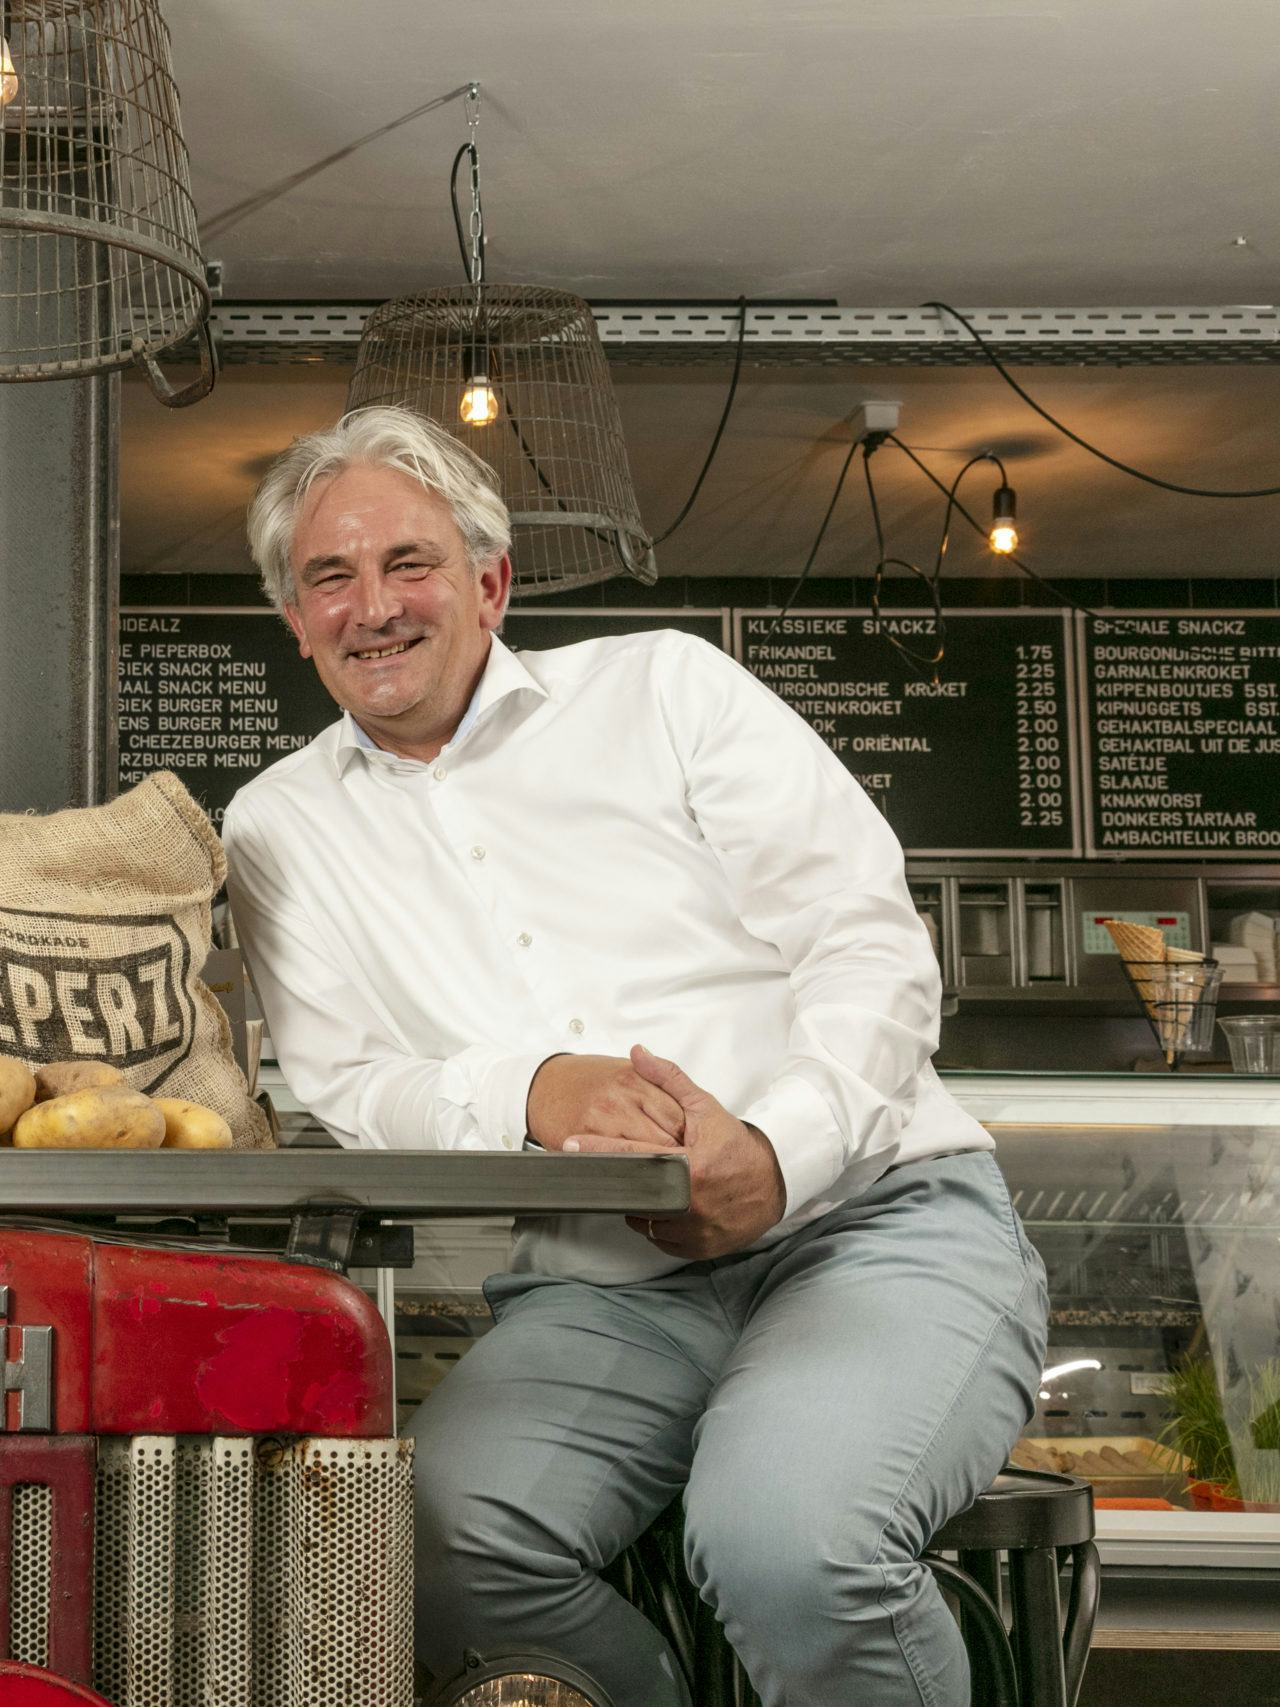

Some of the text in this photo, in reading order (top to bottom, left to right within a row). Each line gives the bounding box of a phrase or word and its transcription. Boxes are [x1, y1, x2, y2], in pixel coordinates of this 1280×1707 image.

[119, 618, 180, 632] IDEALZ
[1177, 620, 1246, 635] SNACKZ
[141, 644, 232, 658] PIEPERBOX
[748, 645, 1053, 660] FRIKANDEL 1.75
[1094, 646, 1236, 661] BOURGONDISCHE
[159, 662, 213, 676] SNACK
[219, 662, 266, 676] MENU
[748, 664, 1055, 679] VIANDEL 2.25
[1094, 665, 1250, 680] GARNALENKROKET
[158, 681, 213, 695] SNACK
[219, 681, 266, 694] MENU
[1016, 682, 1055, 697] 2.25
[1095, 683, 1233, 698] KIPPENBOUTJES
[158, 699, 222, 713] BURGER
[230, 699, 278, 713] MENU
[788, 700, 1057, 716] NTENKROKET 2.50
[1096, 701, 1202, 716] KIPNUGGETS
[158, 717, 222, 731] BURGER
[230, 717, 278, 731] MENU
[1017, 719, 1058, 734] 2.00
[1098, 719, 1277, 735] GEHAKTBALSPECIAAL
[129, 735, 261, 749] CHEEZEBURGER
[852, 734, 931, 752] ORIËNTAL
[1018, 737, 1059, 752] 2.00
[1099, 738, 1195, 753] GEHAKTBAL
[1201, 738, 1224, 753] UIT
[1228, 738, 1251, 753] DE
[214, 753, 261, 767] MENU
[1019, 755, 1061, 770] 2.00
[1099, 754, 1167, 771] SATÉTJE
[854, 773, 1061, 788] KET 2.00
[1100, 775, 1169, 790] SLAATJE
[1019, 792, 1062, 807] 2.00
[1101, 794, 1202, 808] KNAKWORST
[1021, 811, 1063, 826] 2.25
[1102, 812, 1257, 827] DONKERS TARTAAR
[1103, 831, 1230, 845] AMBACHTELIJK
